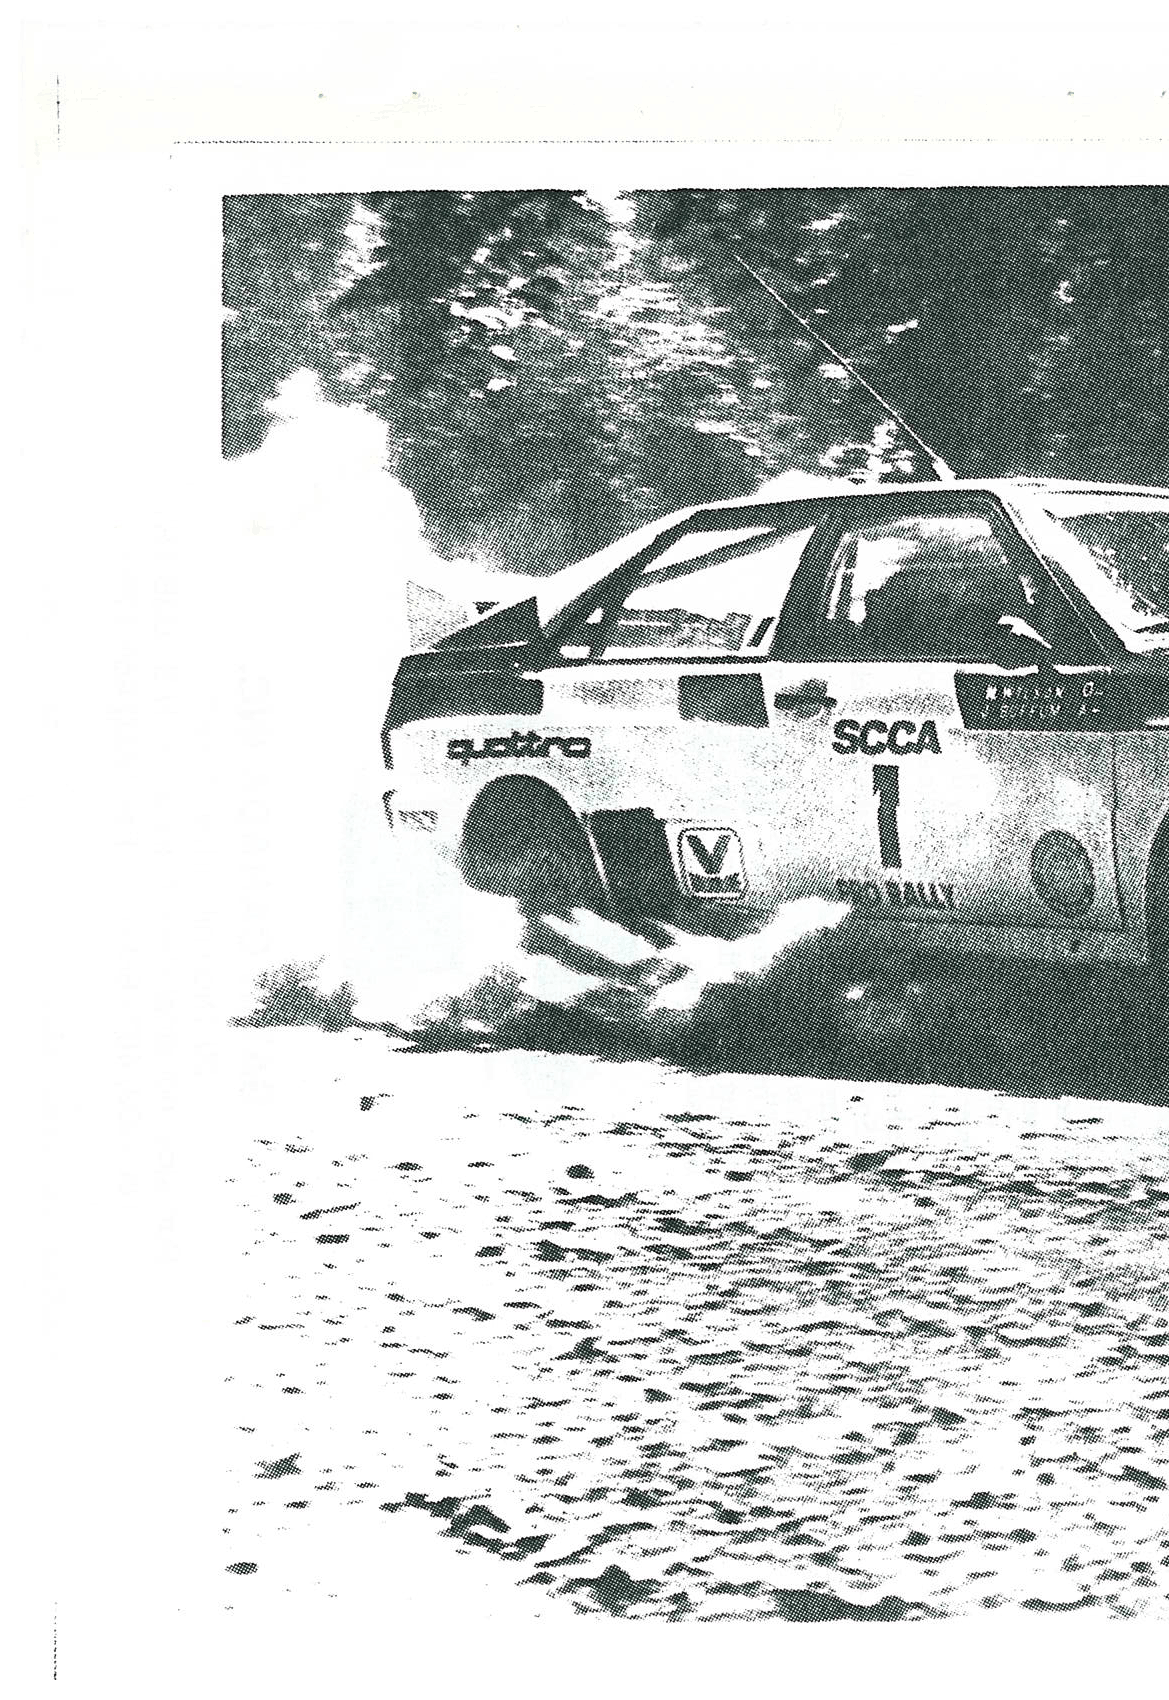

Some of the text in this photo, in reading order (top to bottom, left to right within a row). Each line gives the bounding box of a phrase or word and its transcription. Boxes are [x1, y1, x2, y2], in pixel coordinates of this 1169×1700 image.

[446, 730, 592, 766] quattro
[832, 719, 942, 755] SCCA
[872, 764, 902, 868] 1
[885, 881, 956, 910] RALLY
